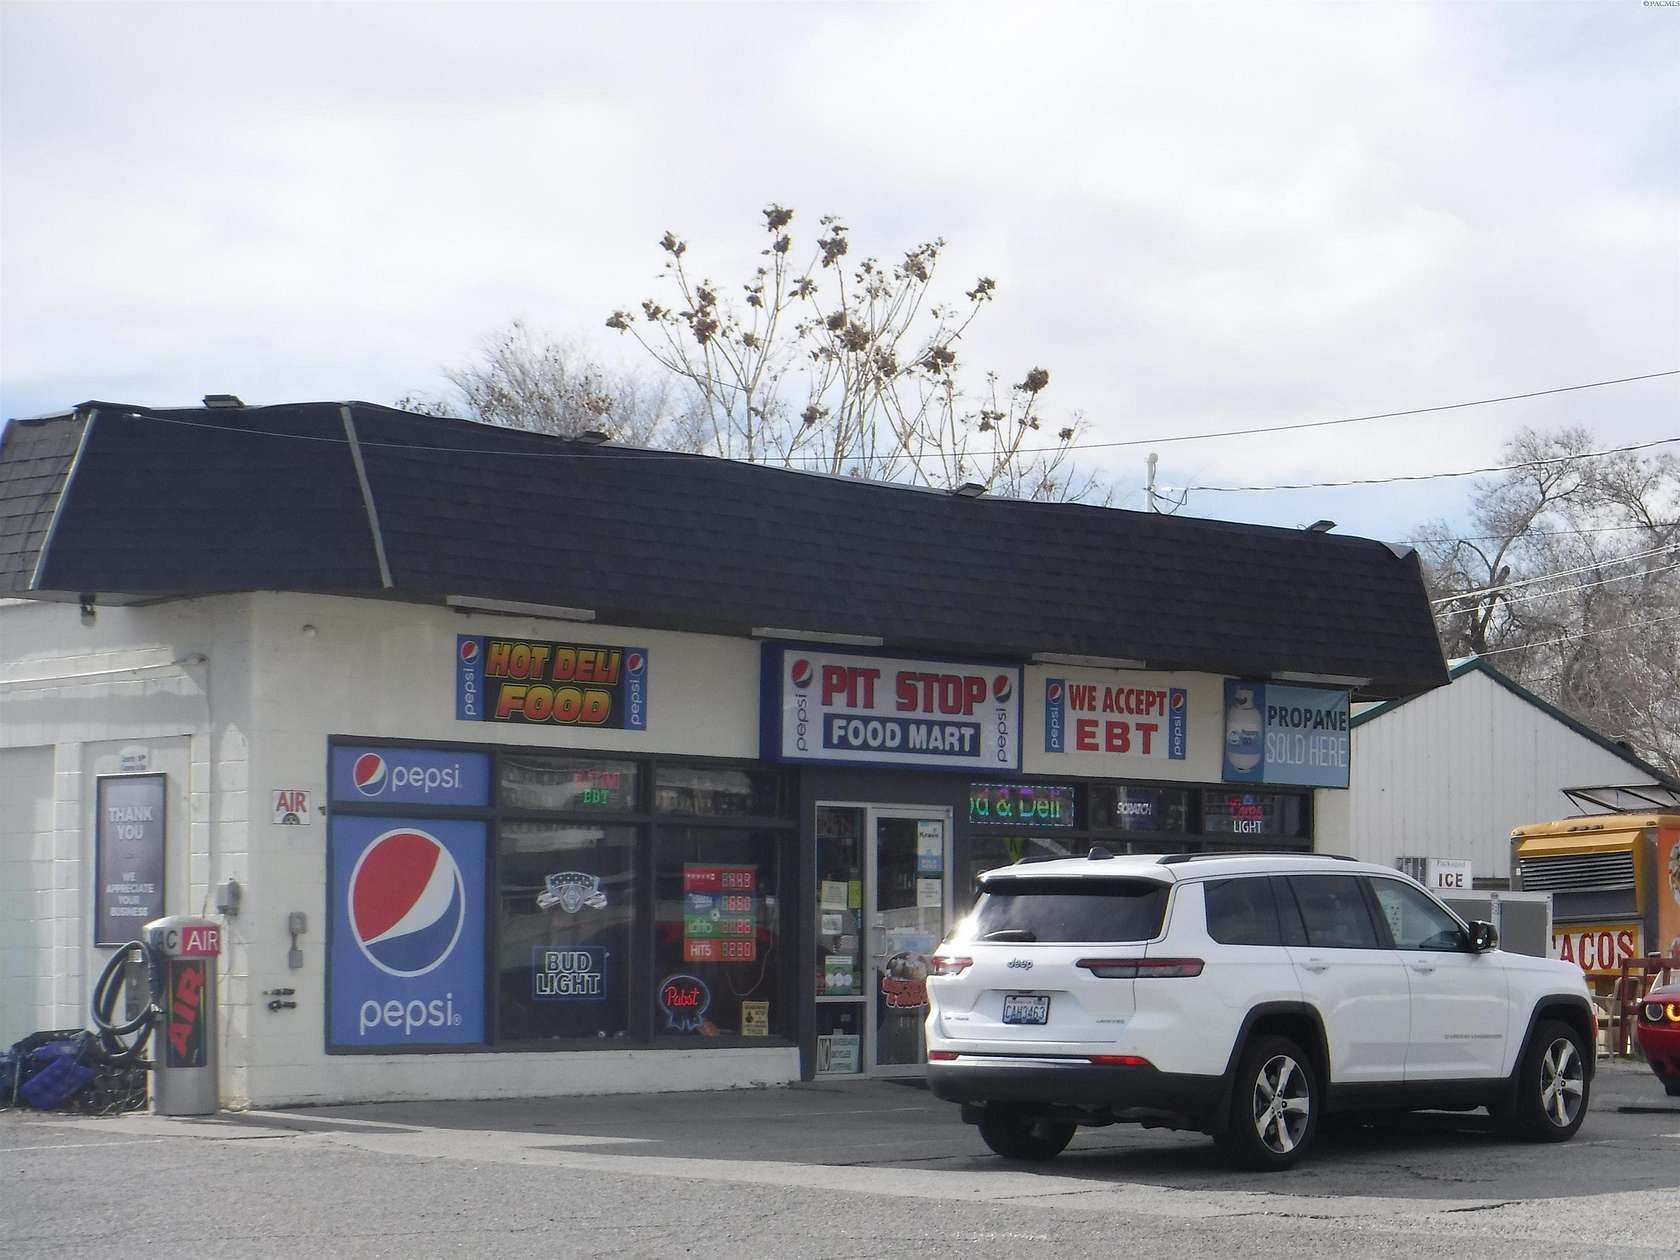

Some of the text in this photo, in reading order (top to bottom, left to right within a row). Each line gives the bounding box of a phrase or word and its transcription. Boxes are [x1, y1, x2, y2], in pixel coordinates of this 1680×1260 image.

[485, 641, 622, 685] HOT DELI
[464, 668, 477, 715] pepsi
[495, 683, 612, 724] FOOD
[630, 679, 642, 724] pepsi
[821, 665, 987, 716] PIT STOP
[1068, 684, 1167, 716] WE ACCEPT
[796, 694, 808, 751] pepsi
[1050, 707, 1060, 748] pepsi
[1267, 705, 1347, 731] PROPANE
[831, 719, 974, 752] FOOD MART
[996, 708, 1008, 763] pepsi
[1076, 719, 1158, 754] EBT
[1174, 716, 1183, 755] pepsi
[1266, 732, 1305, 765] SOLD
[1309, 736, 1347, 768] HERE
[391, 764, 461, 793] pepsi
[108, 807, 153, 822] THANK
[276, 791, 307, 812] AIR
[1018, 788, 1061, 818] Deli
[117, 825, 144, 840] YOU
[1233, 821, 1262, 833] LIGHT
[1438, 873, 1463, 888] ICE
[187, 930, 218, 951] AIR
[1552, 930, 1634, 971] ACOS
[545, 951, 592, 973] BUD
[536, 974, 600, 995] LIGHT
[664, 985, 700, 1008] Pabst
[168, 966, 206, 1058] AIR
[1005, 1005, 1046, 1021] CAH3463
